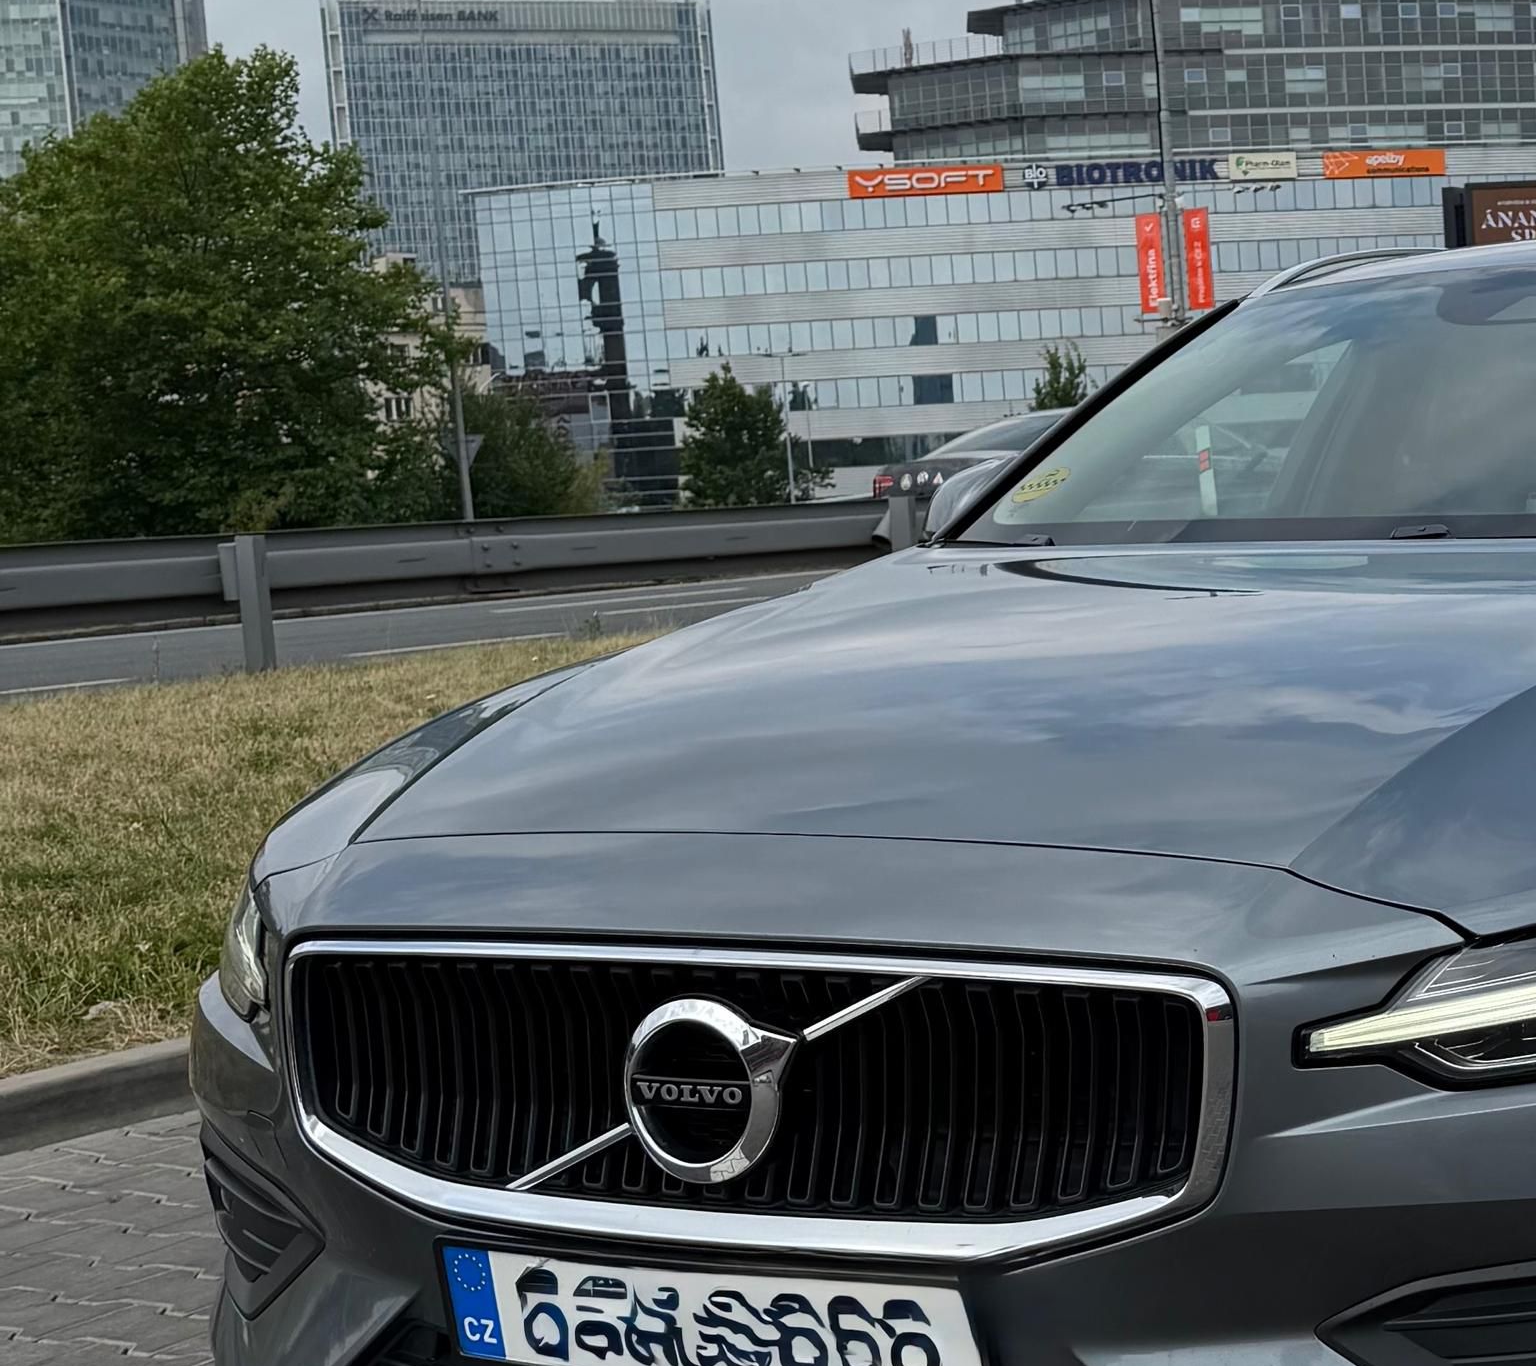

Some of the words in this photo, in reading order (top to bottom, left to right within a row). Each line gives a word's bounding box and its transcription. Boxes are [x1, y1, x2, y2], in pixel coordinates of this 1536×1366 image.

[385, 9, 453, 22] Raiffisen
[457, 10, 499, 22] BANK
[854, 170, 994, 193] YSOFT
[1147, 248, 1160, 308] Elektřina
[636, 1081, 743, 1105] VOLVO
[463, 1316, 498, 1344] CZ
